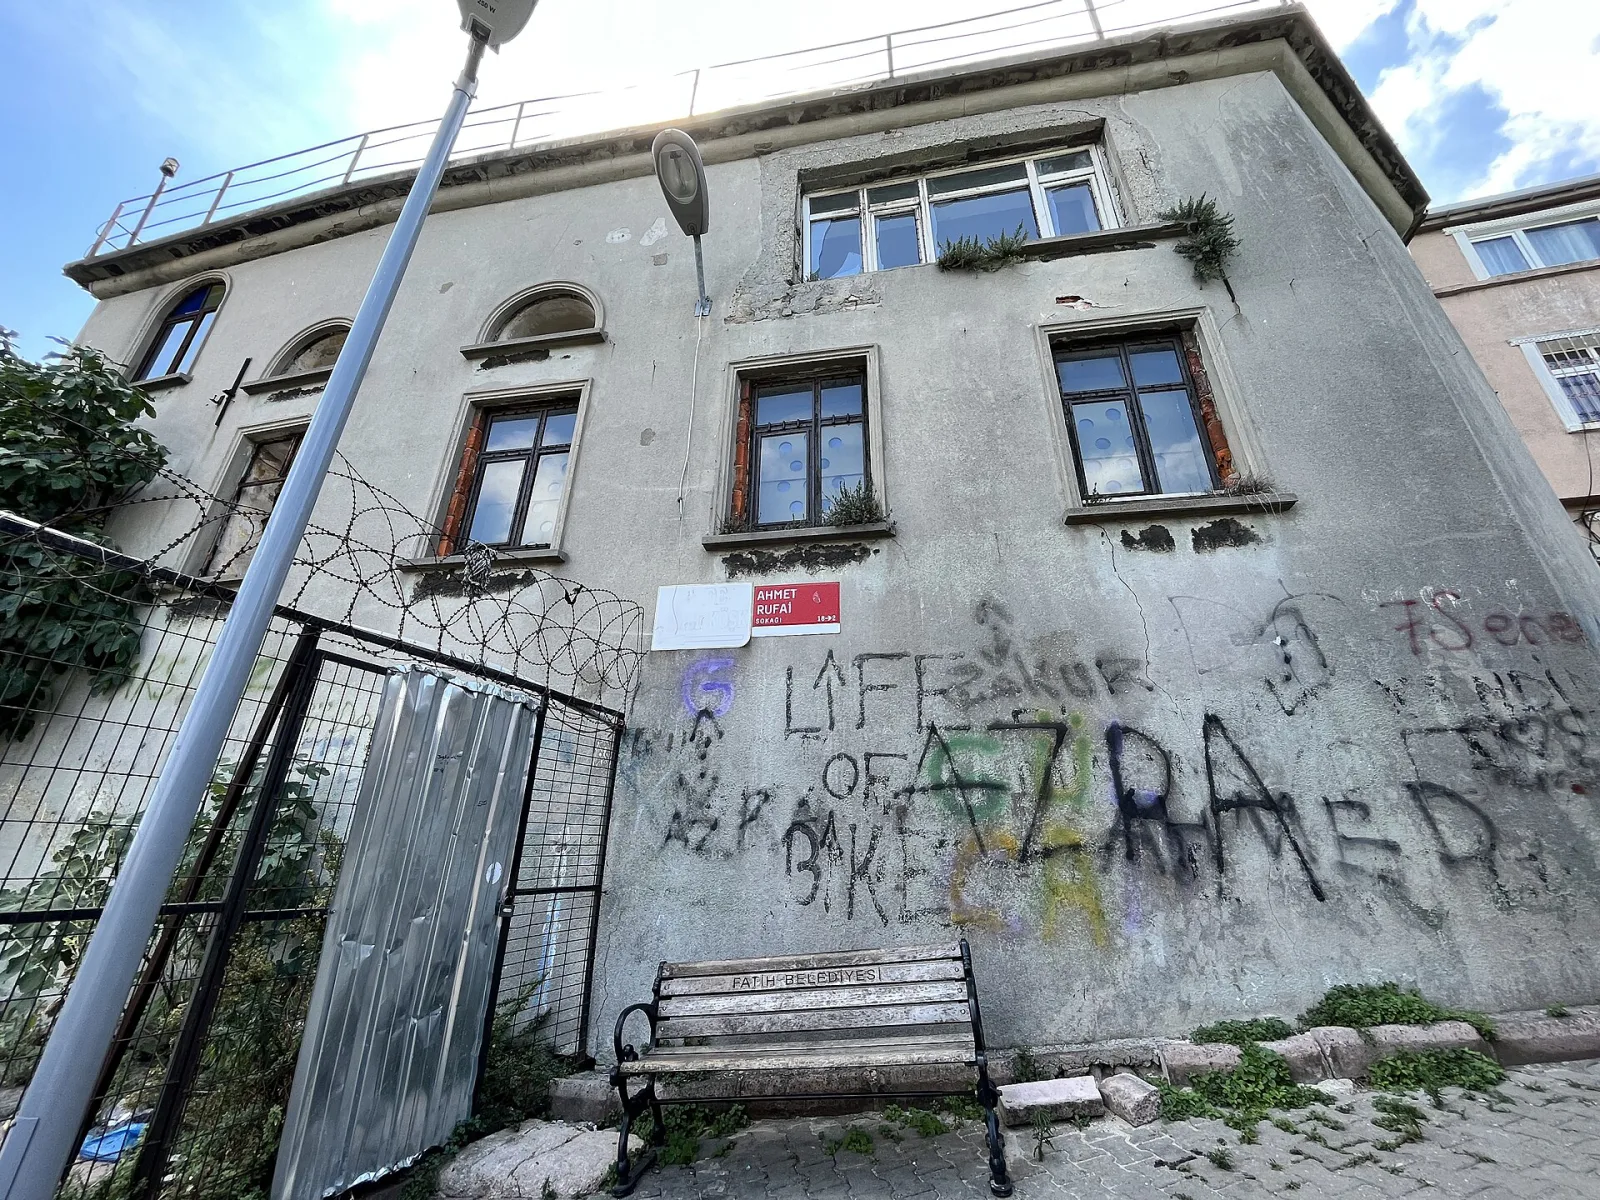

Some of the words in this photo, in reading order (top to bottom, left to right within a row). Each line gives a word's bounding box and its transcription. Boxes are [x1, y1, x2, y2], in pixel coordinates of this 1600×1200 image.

[756, 588, 798, 601] AHMET
[784, 648, 972, 738] LIFE
[822, 752, 908, 809] OF
